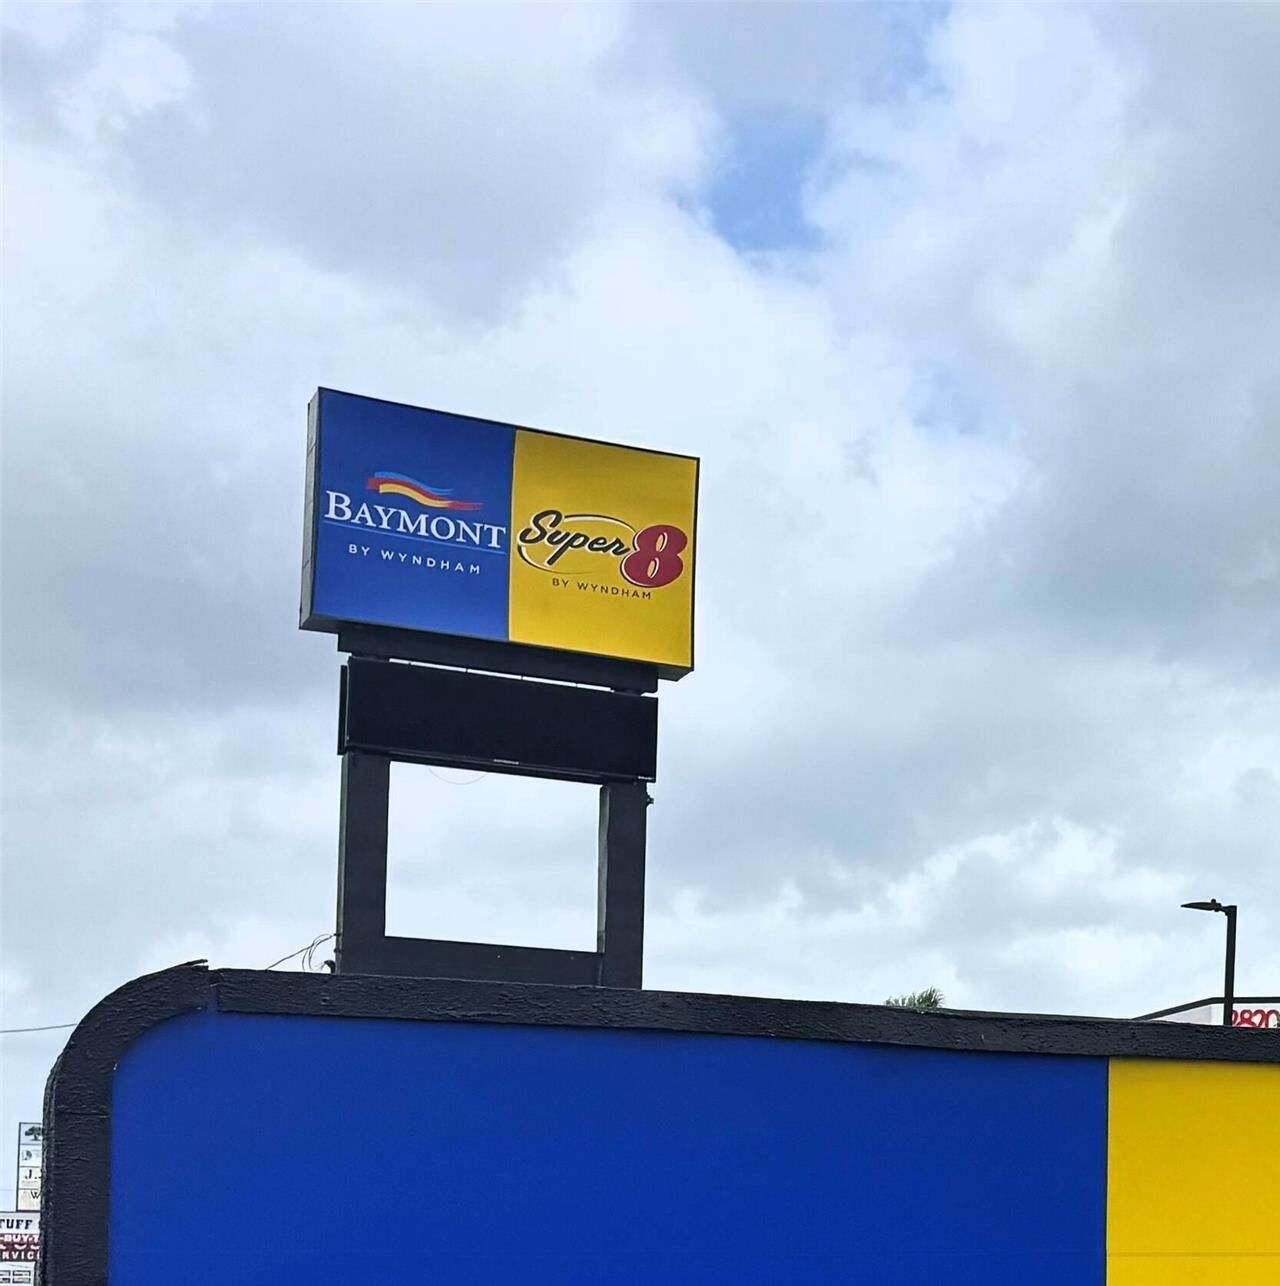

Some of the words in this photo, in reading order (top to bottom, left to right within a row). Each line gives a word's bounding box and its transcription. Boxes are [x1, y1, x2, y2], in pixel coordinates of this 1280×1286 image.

[324, 490, 507, 548] BAYMONT
[349, 544, 370, 556] BY
[381, 550, 480, 575] WYNDHAM
[518, 510, 631, 567] Super
[620, 524, 688, 589] 8
[552, 577, 569, 588] BY
[577, 582, 652, 600] WYNDHAM
